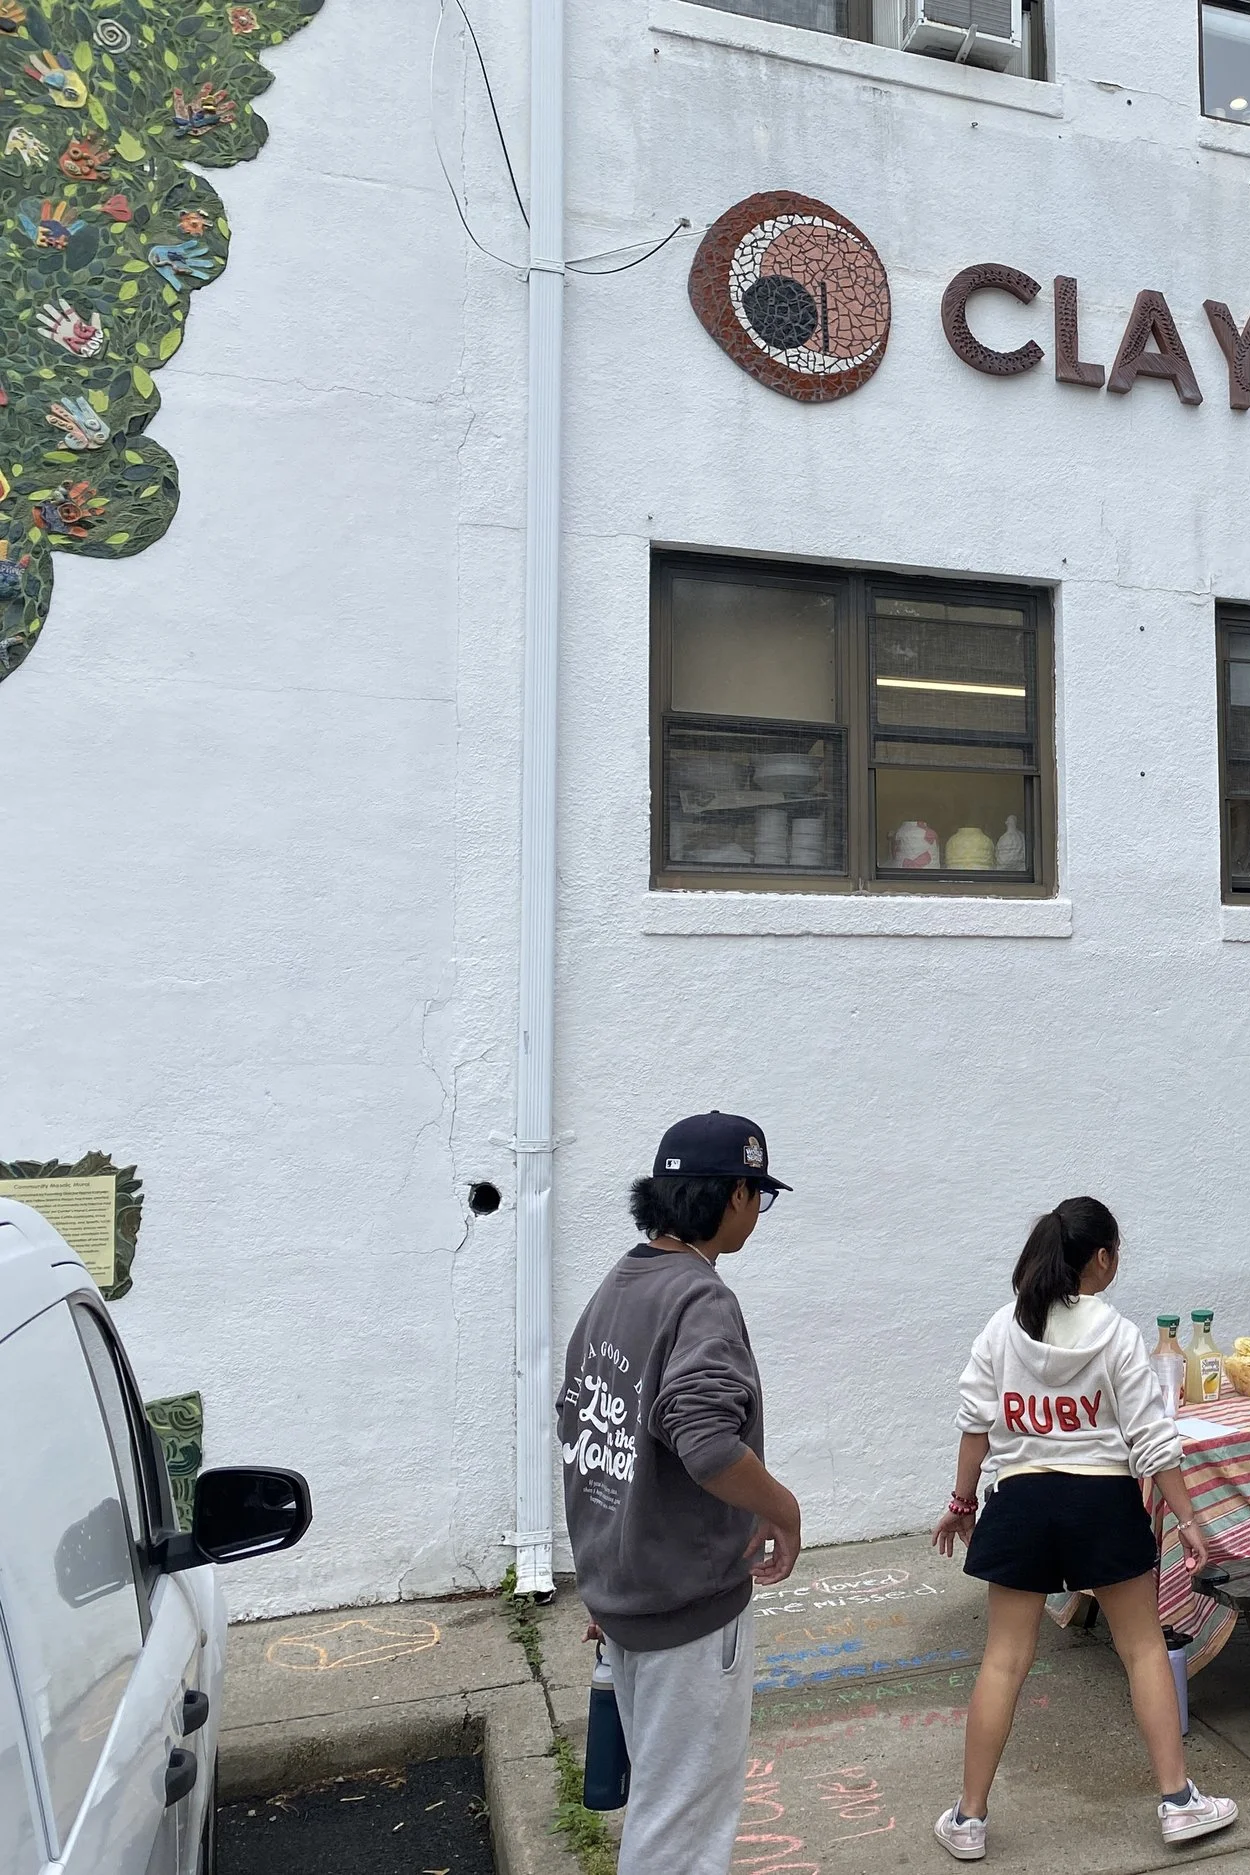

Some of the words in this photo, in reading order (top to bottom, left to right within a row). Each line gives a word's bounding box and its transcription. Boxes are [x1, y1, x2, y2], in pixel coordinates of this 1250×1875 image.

[588, 1342, 597, 1360] A
[601, 1341, 630, 1373] GOOD
[579, 1375, 628, 1434] Live
[1003, 1389, 1102, 1436] RUBY
[614, 1427, 636, 1451] the
[822, 1574, 901, 1593] loved
